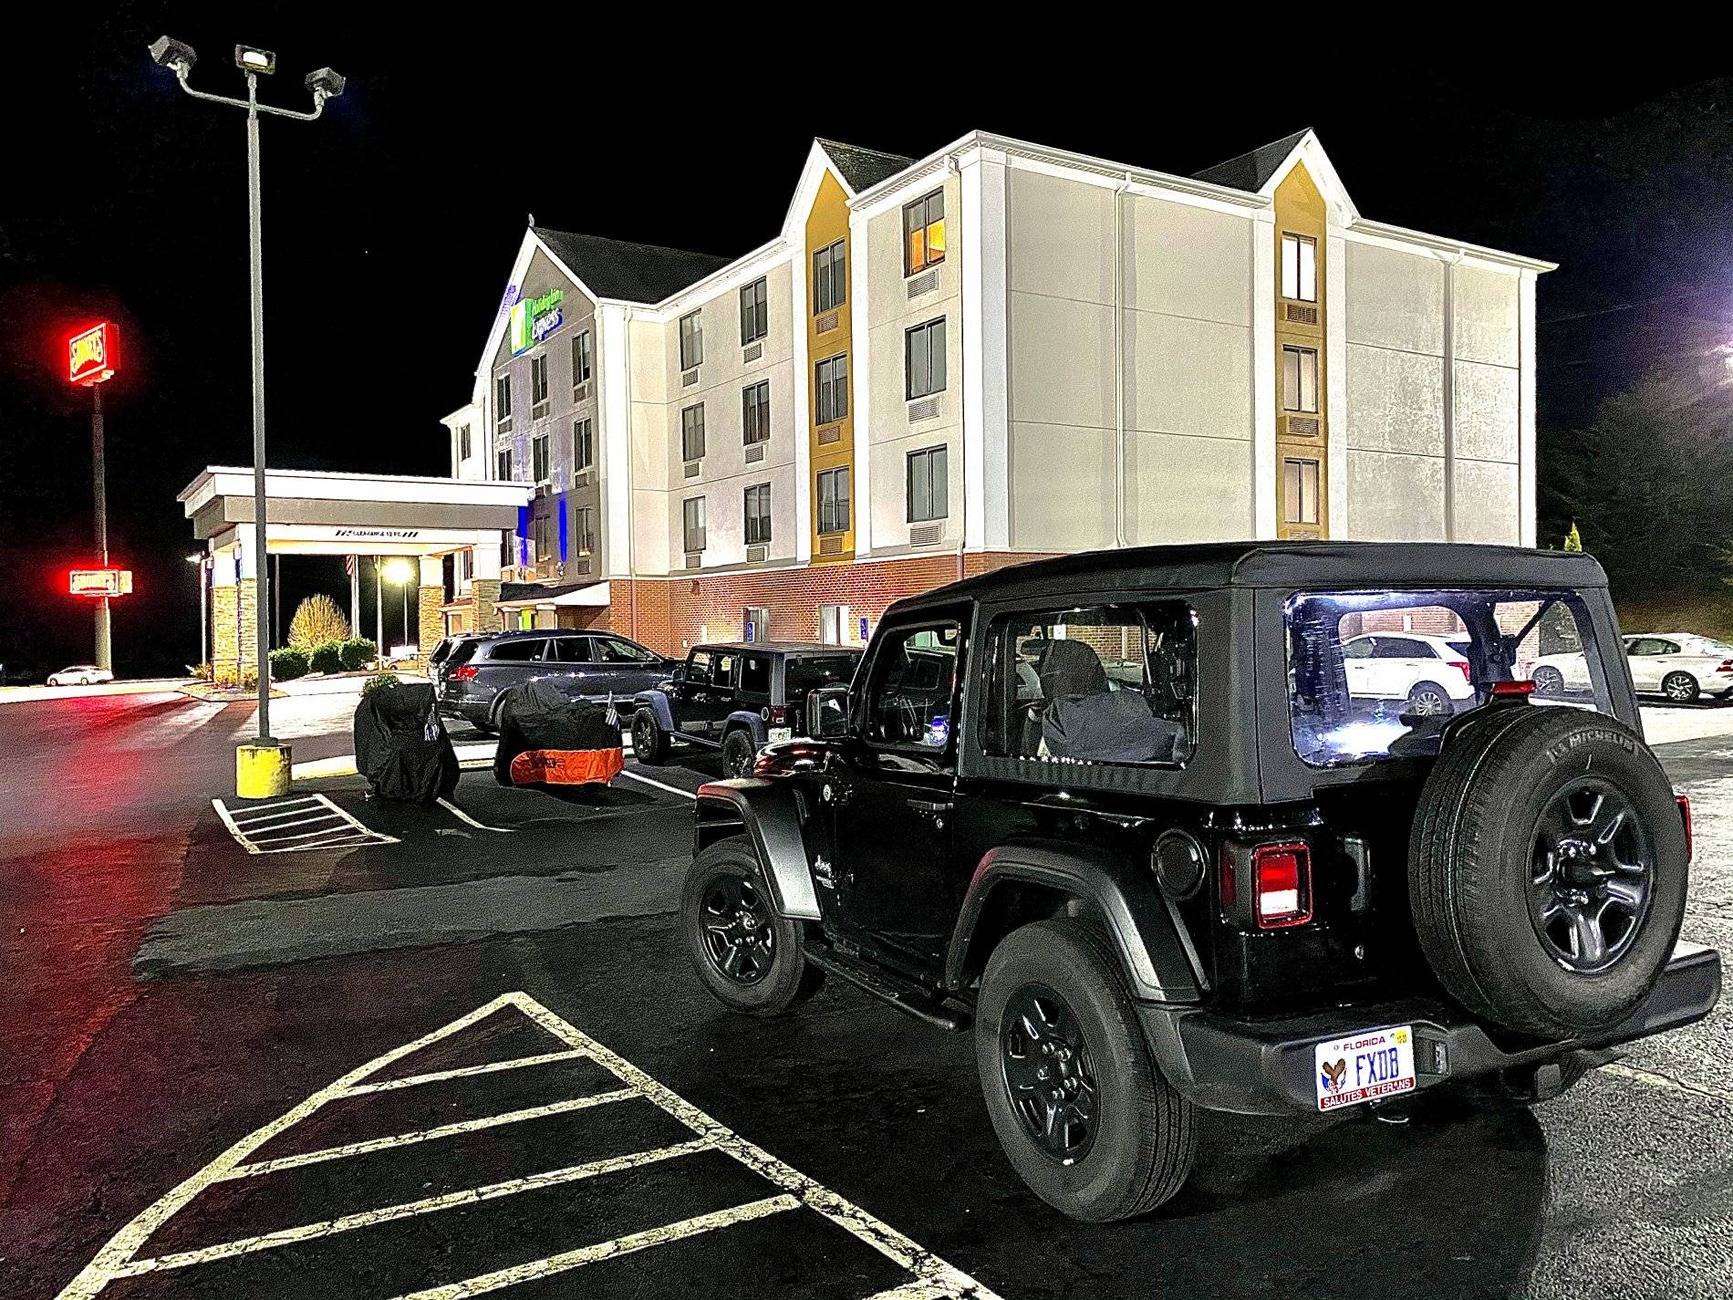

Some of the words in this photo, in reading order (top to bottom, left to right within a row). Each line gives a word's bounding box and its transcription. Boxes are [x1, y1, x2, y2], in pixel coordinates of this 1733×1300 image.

[1343, 1036, 1386, 1051] FLORIDA
[1356, 1047, 1400, 1087] FXDB
[1323, 1089, 1363, 1108] SALUTES
[1366, 1079, 1411, 1097] VETERANS
